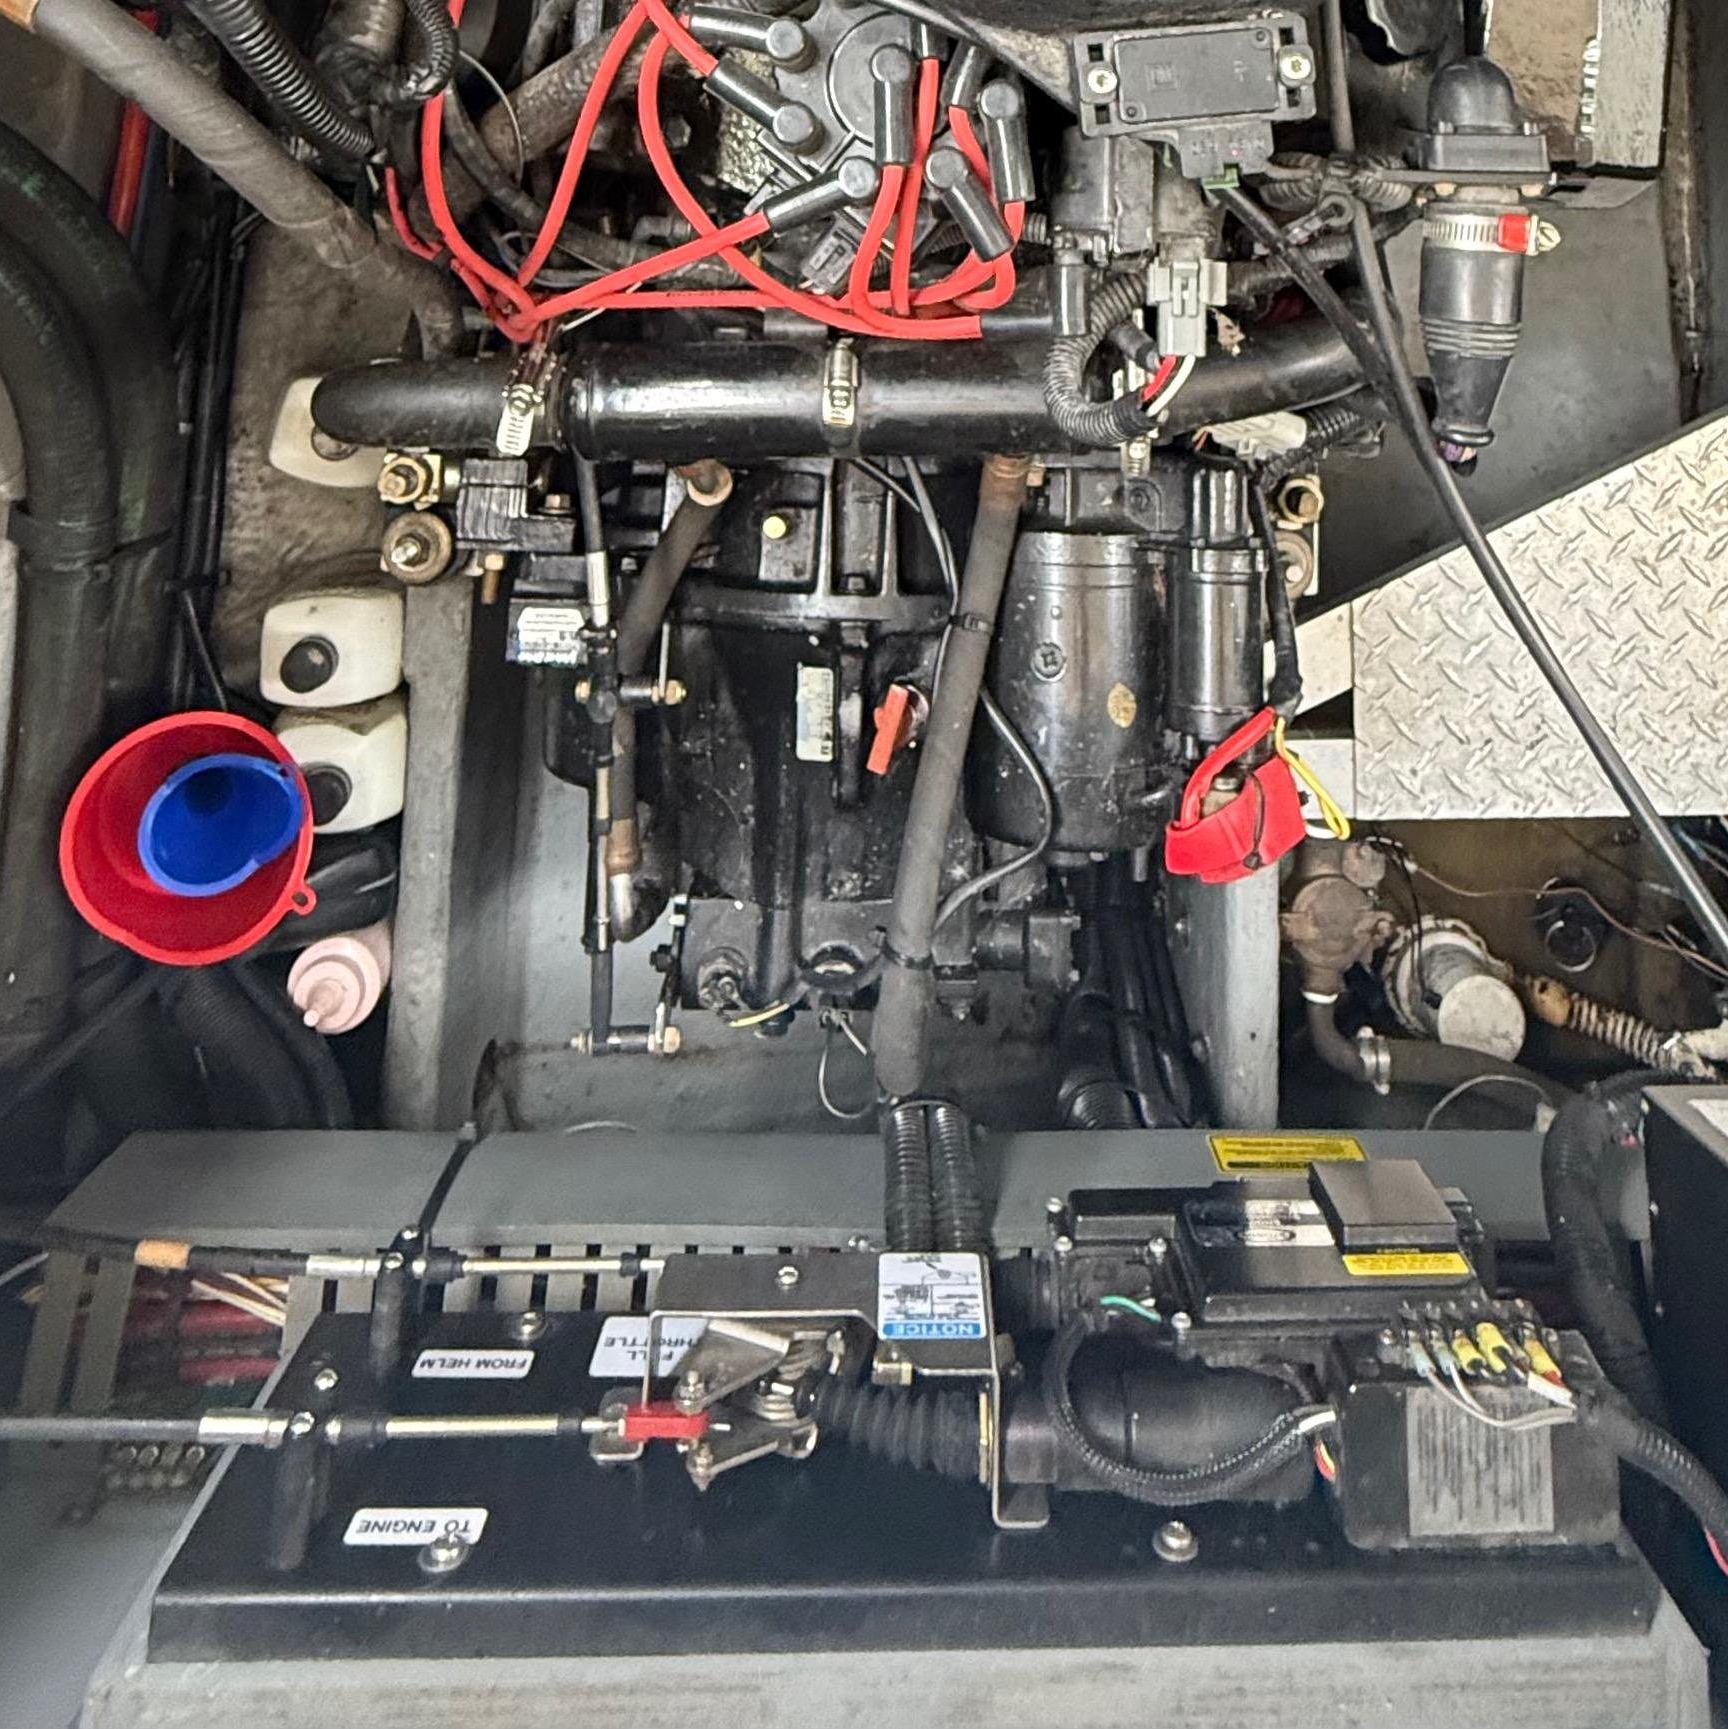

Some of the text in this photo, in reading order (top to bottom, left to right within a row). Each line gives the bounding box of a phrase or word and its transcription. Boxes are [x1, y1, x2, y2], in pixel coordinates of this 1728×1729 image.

[893, 1324, 973, 1336] NOTICE
[604, 1337, 697, 1348] HROTTLE
[626, 1351, 673, 1360] FLL
[419, 1358, 527, 1370] FROM HELM
[356, 1520, 471, 1534] TO ENGINE
